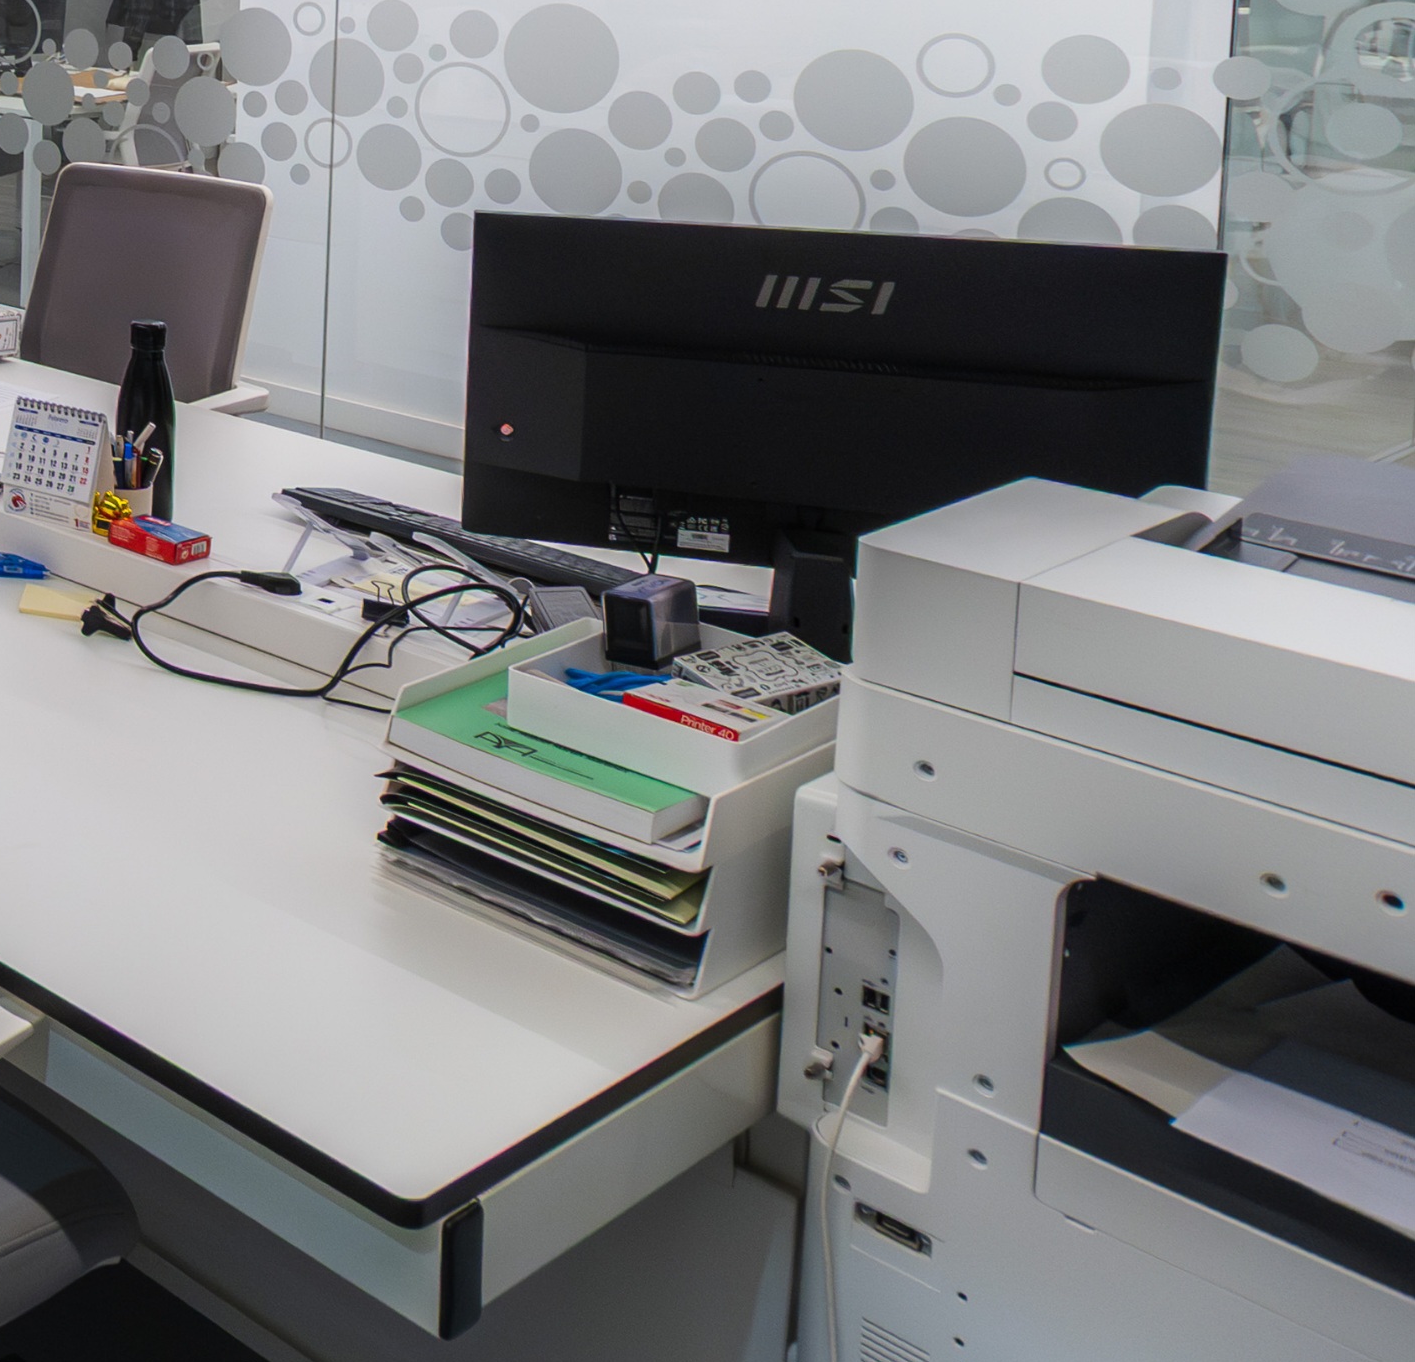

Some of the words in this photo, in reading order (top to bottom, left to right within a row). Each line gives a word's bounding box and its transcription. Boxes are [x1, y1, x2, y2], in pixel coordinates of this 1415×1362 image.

[755, 274, 896, 315] MSI
[680, 714, 717, 734] Printer
[717, 728, 735, 740] 40
